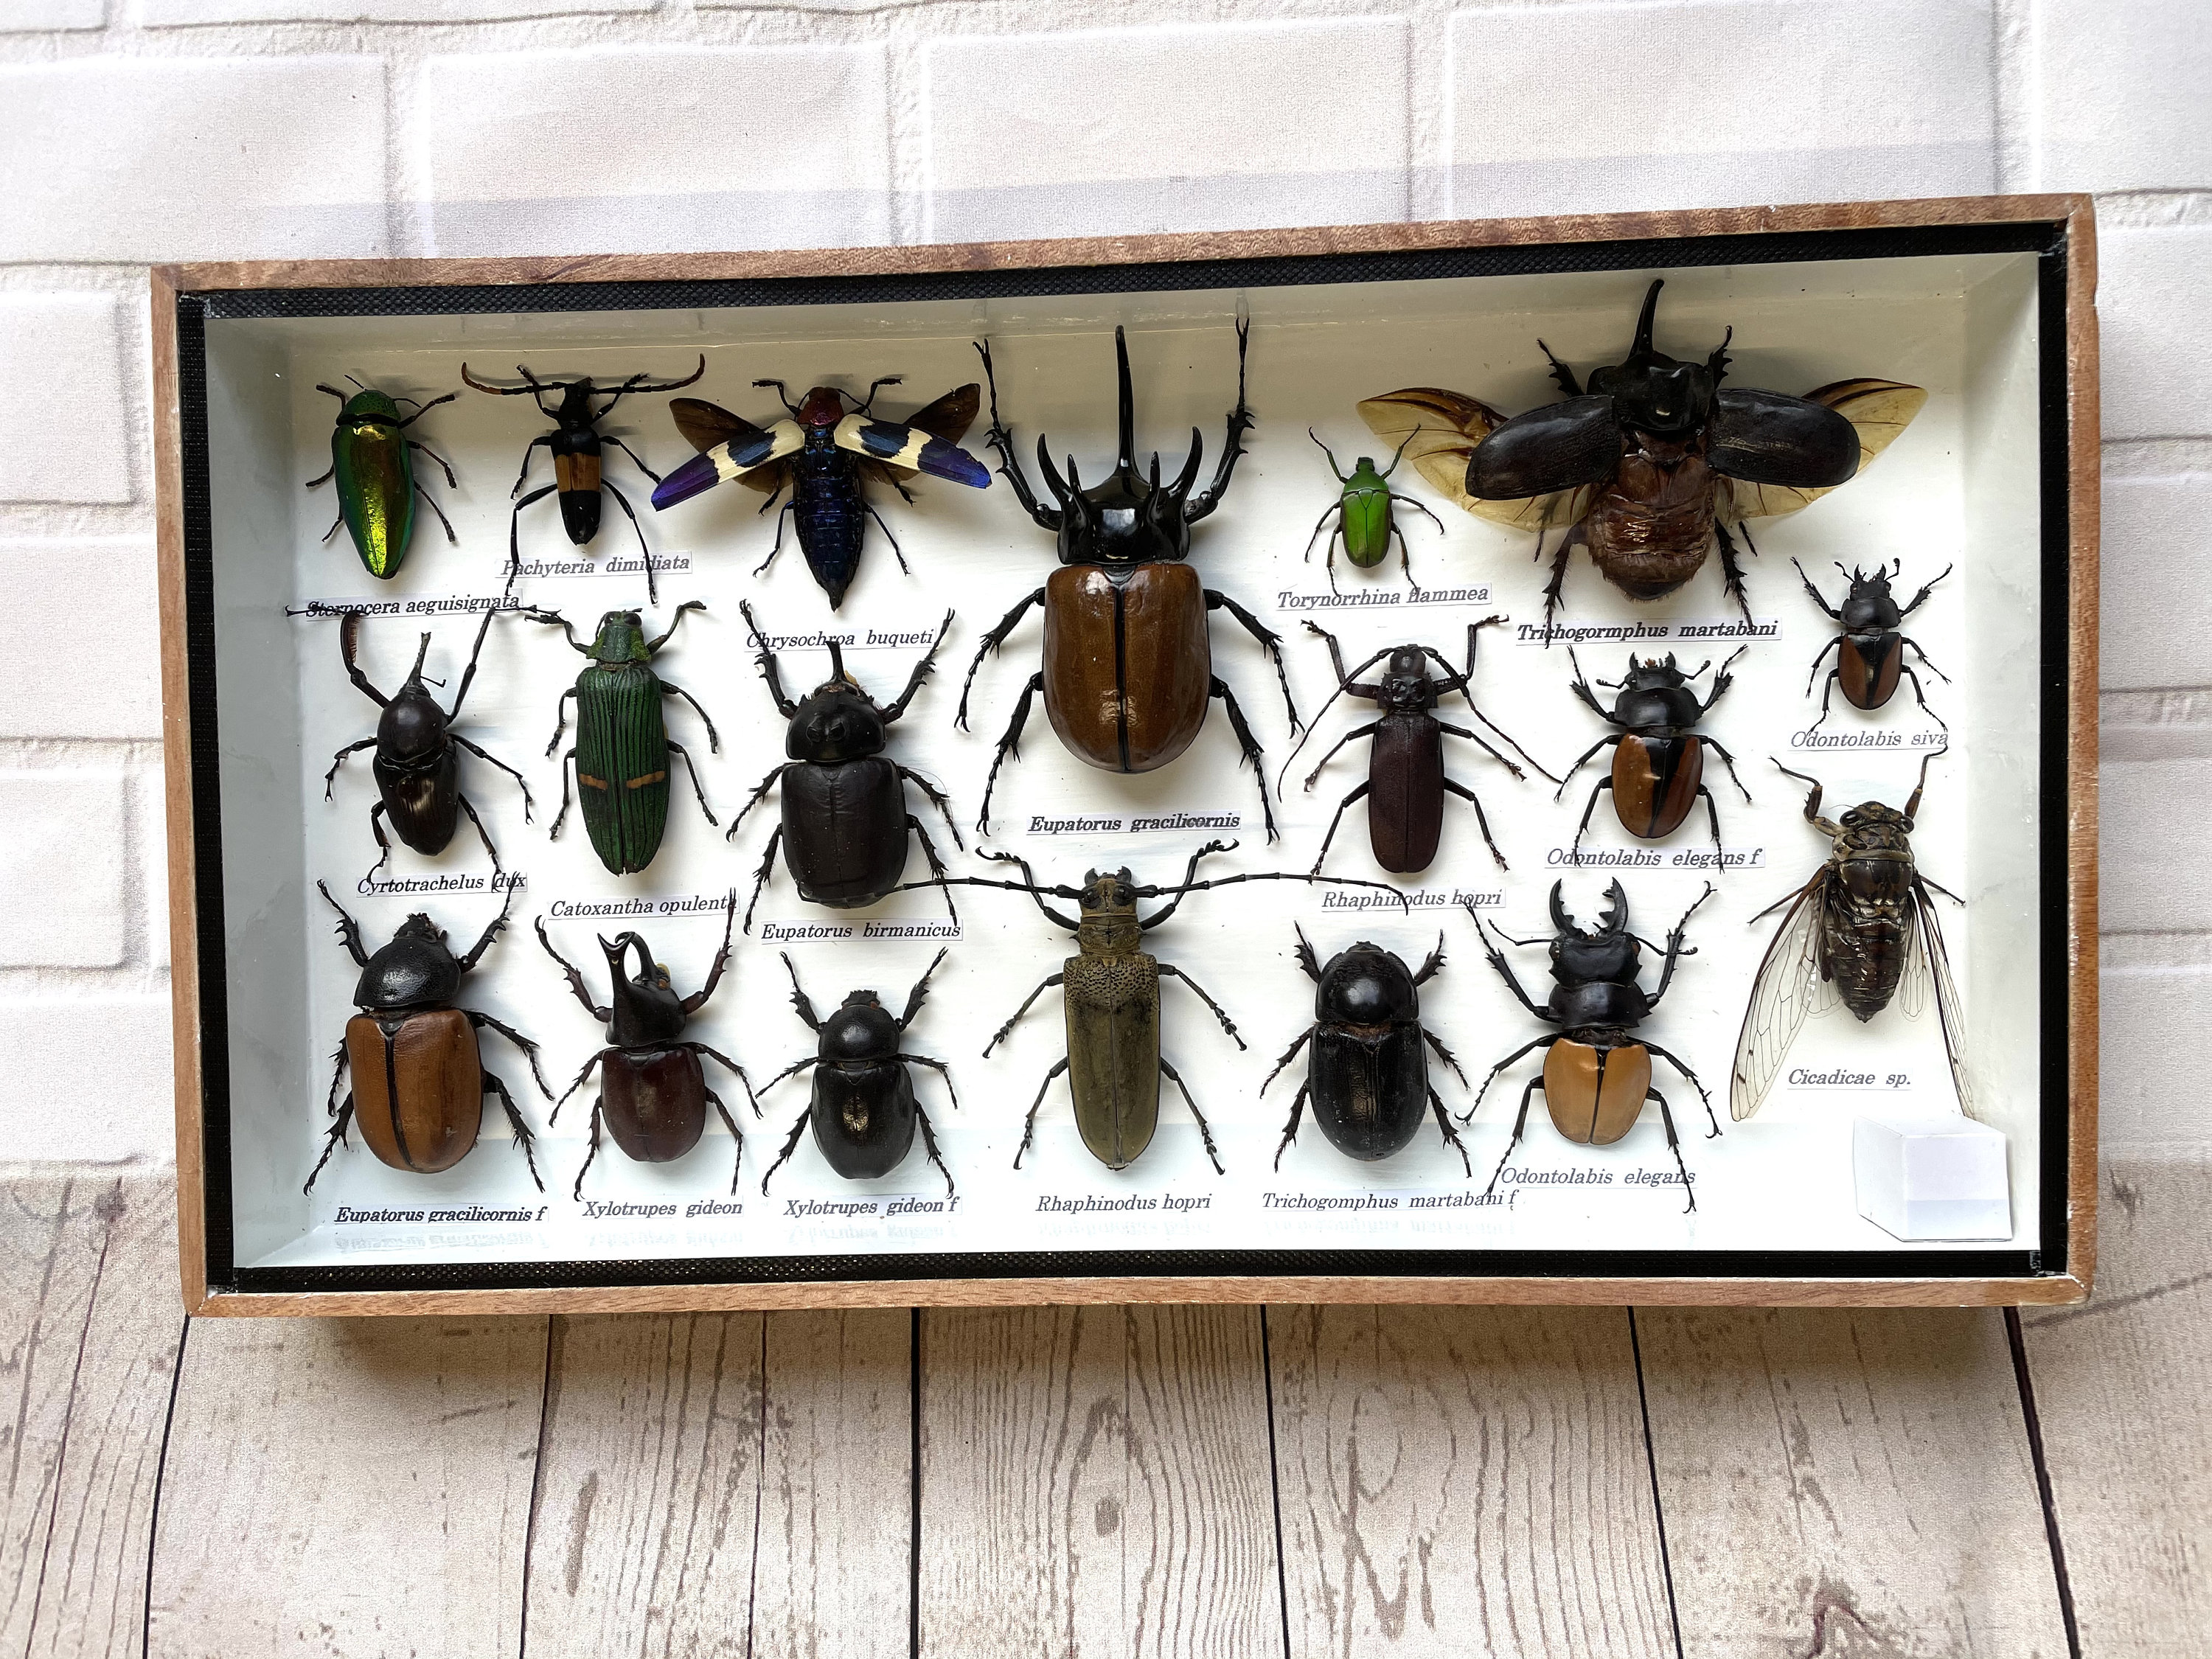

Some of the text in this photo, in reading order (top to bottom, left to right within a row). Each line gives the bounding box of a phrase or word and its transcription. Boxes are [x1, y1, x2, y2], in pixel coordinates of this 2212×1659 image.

[500, 554, 690, 578] Pachyteria dimidiata
[406, 594, 520, 615] aeguisignata
[1278, 586, 1489, 611] Torynorrhina flammea
[1677, 620, 1778, 637] martabani
[746, 629, 934, 650] Chrysochroa buqueti
[1791, 730, 1949, 748] Odontolabis siva
[1027, 813, 1240, 835] Eupatorus gracilicornis
[1547, 848, 1763, 869] Odontolabis elegans f
[357, 874, 484, 896] Cyrtotrachelus
[550, 898, 654, 917] Catoxantha
[1321, 888, 1503, 911] Rhaphinodus hopri
[761, 922, 961, 942] Eupatorus birmanicus
[1788, 1068, 1912, 1088] Cicadicae sp.
[1500, 1167, 1697, 1188] Odontolabis elegans
[582, 1199, 743, 1219] Xylotrupes gideon
[782, 1195, 961, 1218] Xylotrupes gideon f
[1034, 1193, 1213, 1215] Rhaphinodus hopri
[1262, 1189, 1520, 1212] Trichogomphus martabani f
[333, 1205, 548, 1224] Eupatorus gracilicornis f
